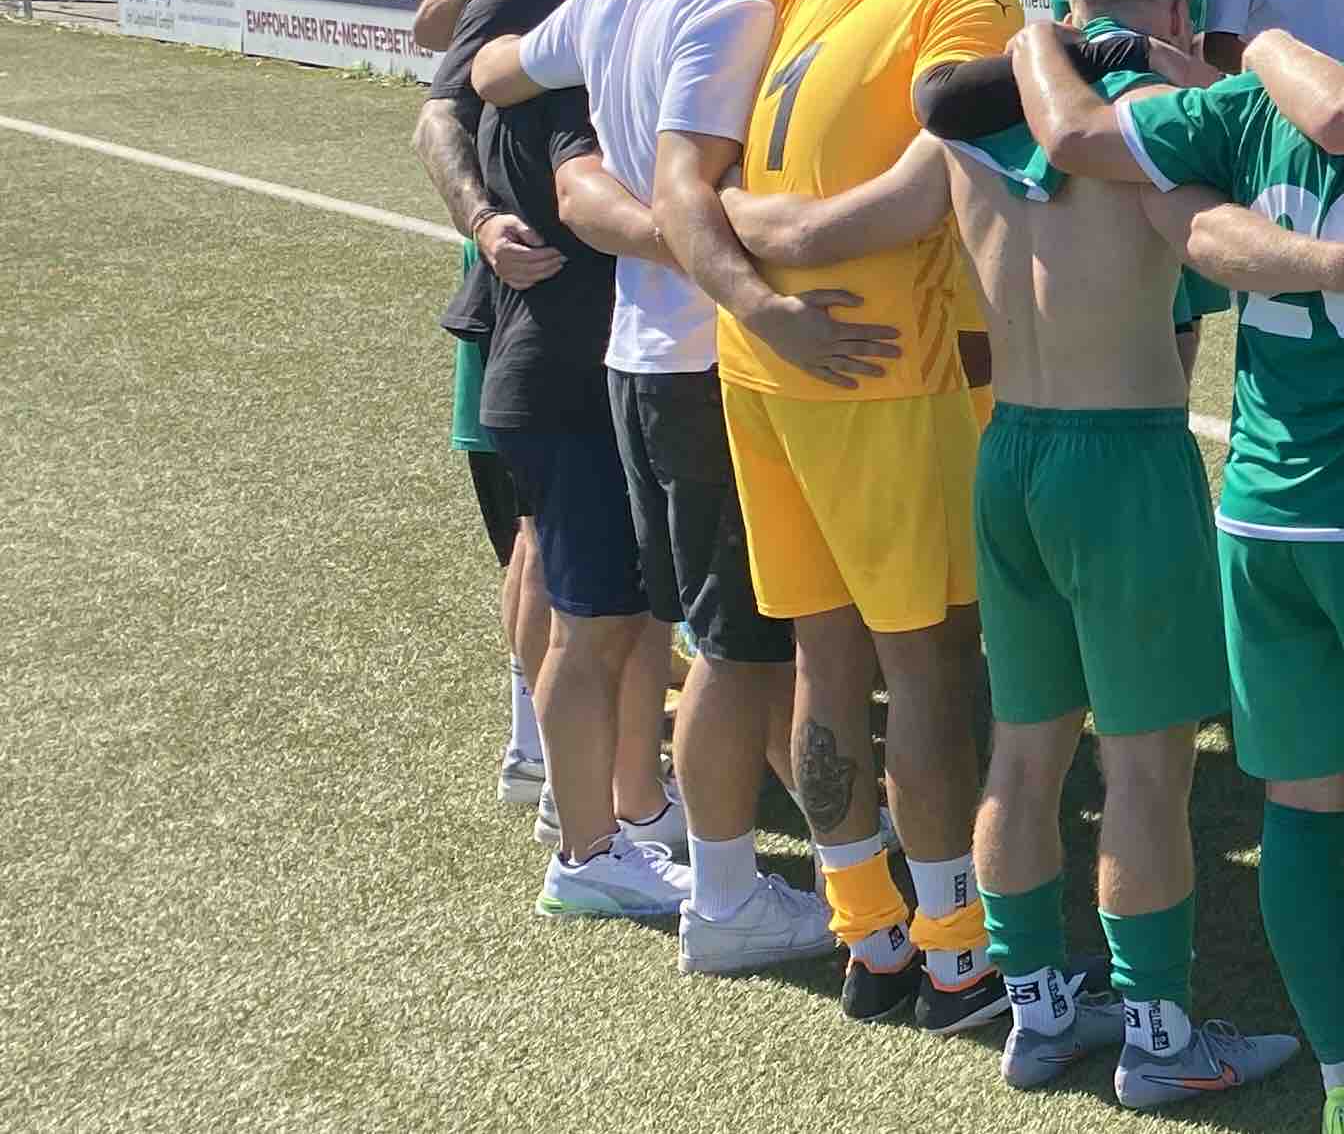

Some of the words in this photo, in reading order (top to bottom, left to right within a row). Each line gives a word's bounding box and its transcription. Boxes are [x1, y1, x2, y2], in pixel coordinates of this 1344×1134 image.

[247, 9, 319, 42] EMPFOHLENER
[319, 18, 433, 58] KFZ-MEISTERBETR
[765, 41, 823, 171] 1
